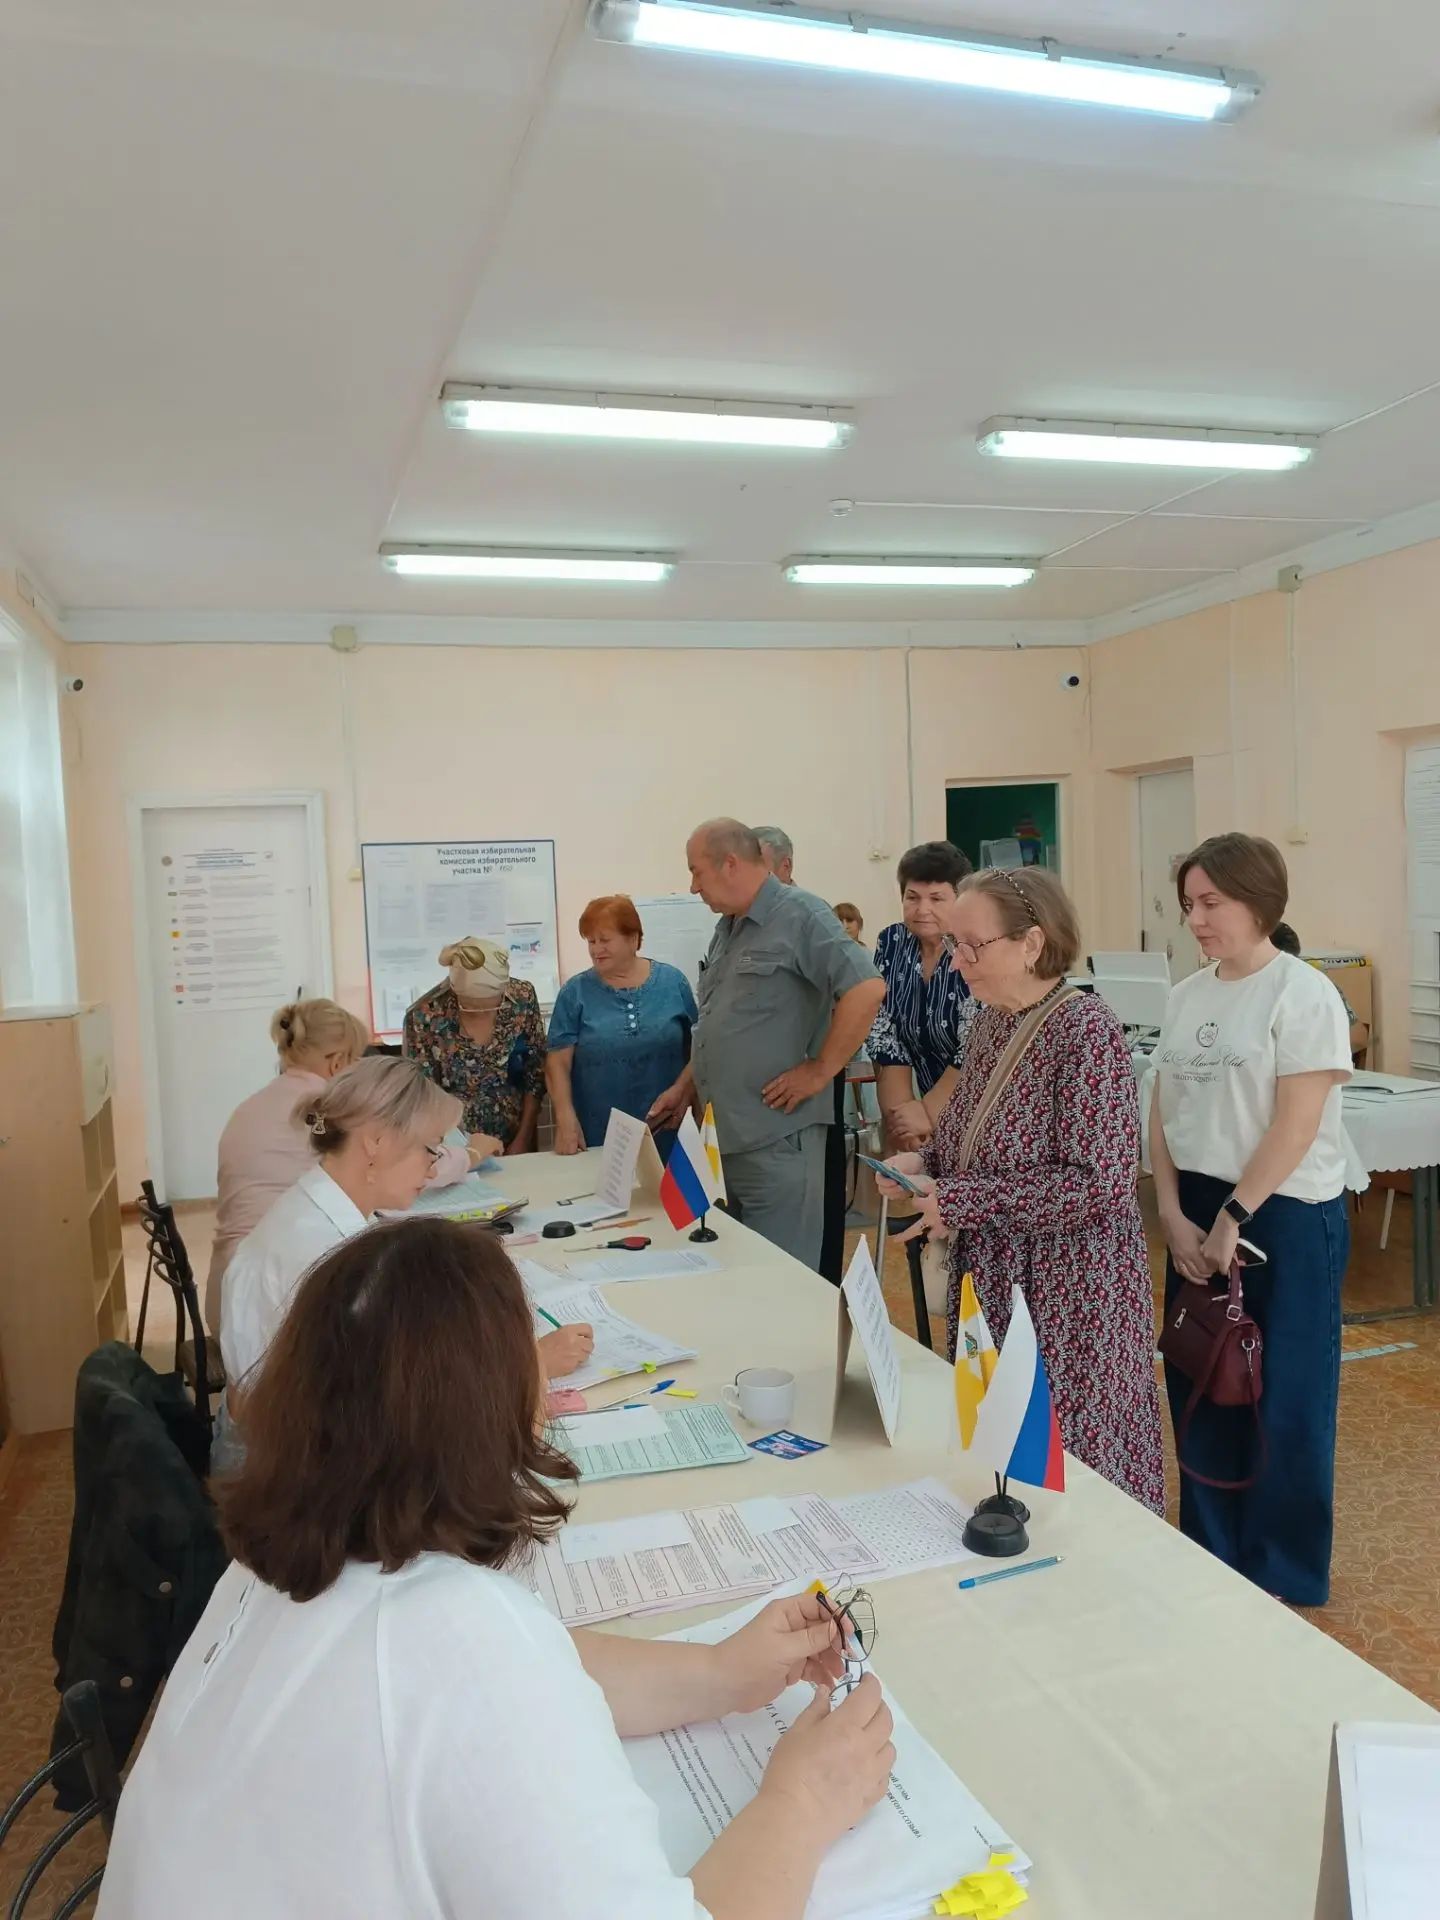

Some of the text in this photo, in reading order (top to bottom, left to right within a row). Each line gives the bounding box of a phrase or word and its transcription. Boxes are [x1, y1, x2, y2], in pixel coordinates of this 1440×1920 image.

[481, 847, 536, 855] избирательная
[478, 856, 536, 864] избирательного
[452, 867, 481, 876] участка
